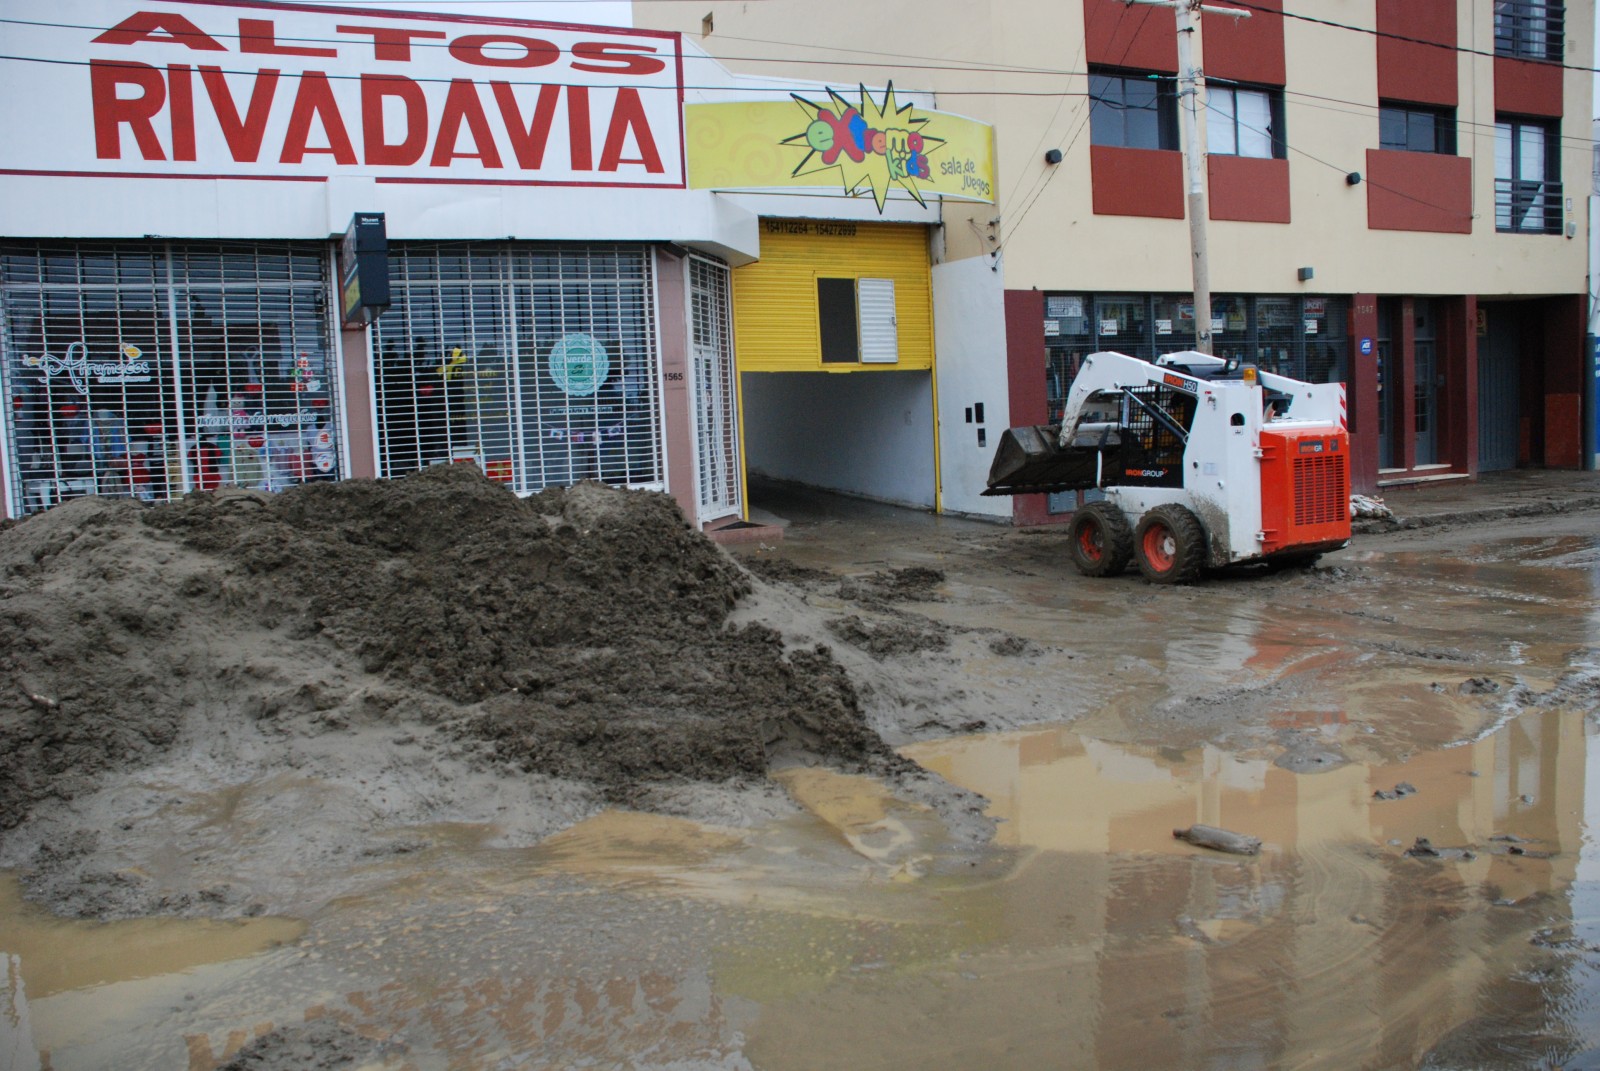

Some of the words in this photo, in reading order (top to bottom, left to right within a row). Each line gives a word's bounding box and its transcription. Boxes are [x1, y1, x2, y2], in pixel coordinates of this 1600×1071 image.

[90, 11, 666, 75] ALTOS
[89, 58, 666, 174] RIVADAVIA
[885, 147, 931, 181] kids
[940, 156, 962, 175] sala
[663, 372, 683, 381] 1565
